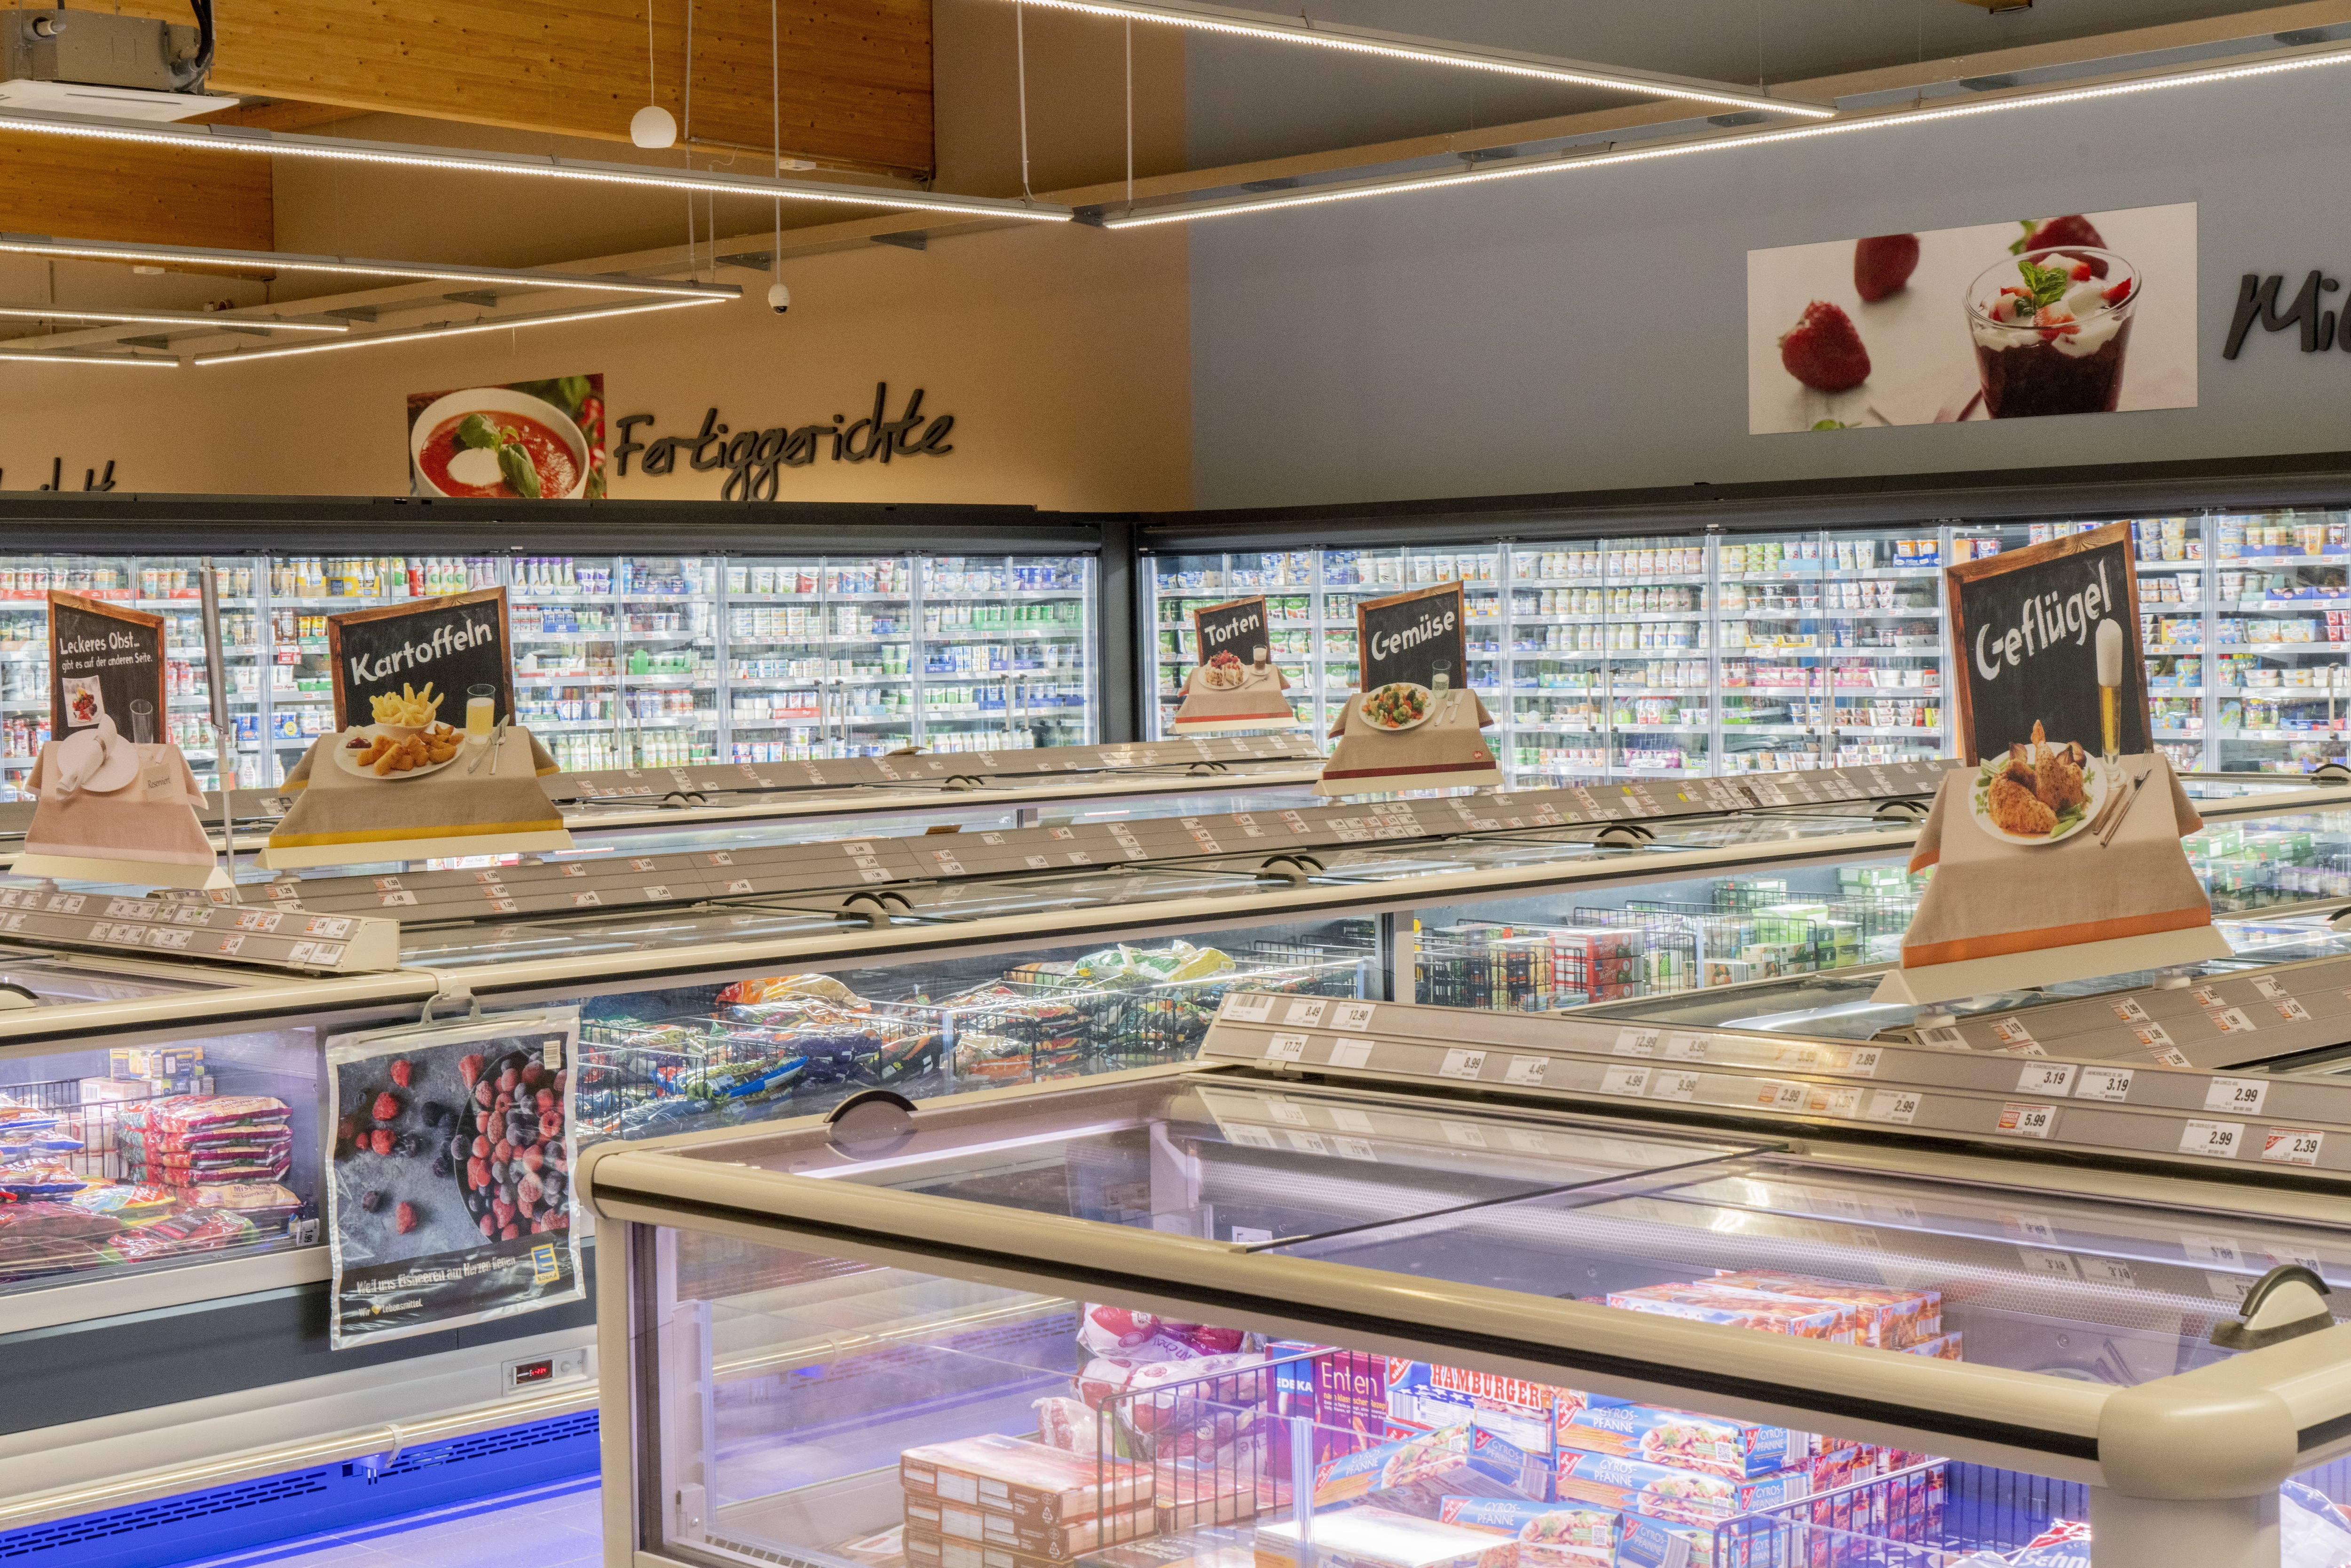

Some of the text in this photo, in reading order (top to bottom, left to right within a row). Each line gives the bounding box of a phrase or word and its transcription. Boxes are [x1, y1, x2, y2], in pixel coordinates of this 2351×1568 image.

[2223, 270, 2351, 360] Mi
[613, 382, 954, 502] Fertiggerichte
[1976, 558, 2111, 680] Geflügel
[1205, 614, 1260, 646] Torten
[1372, 611, 1455, 661] Gemüse
[60, 631, 140, 655] Leckeres Obst...
[351, 619, 492, 685] Kartoffeln
[62, 659, 73, 673] gibt
[84, 657, 94, 668] auf
[96, 655, 106, 666] der
[108, 655, 133, 666] anderen
[135, 652, 152, 663] Seite.
[147, 775, 171, 788] Reserviert
[2269, 981, 2283, 991] 2.49
[2204, 989, 2219, 1000] 2.99
[1305, 1006, 1321, 1017] 8.49
[1349, 1009, 1368, 1021] 12.90
[2126, 1004, 2140, 1015] 2.99
[2288, 1004, 2303, 1014] 2.49
[2225, 1015, 2240, 1025] 1.99
[2007, 1024, 2022, 1034] 3.19
[2148, 1029, 2163, 1040] 2.89
[1283, 1041, 1302, 1052] 17.72
[1635, 1036, 1657, 1048] 12.99
[1689, 1040, 1708, 1052] 8.99
[1464, 1056, 1480, 1070] 8.99
[1856, 1053, 1876, 1066] 2.89
[2168, 1054, 2184, 1065] 2.99
[1529, 1064, 1546, 1075] 4.49
[1625, 1075, 1643, 1087] 4.99
[2043, 1072, 2066, 1084] 3.19
[2106, 1078, 2129, 1091] 3.19
[1677, 1079, 1696, 1092] 9.99
[1781, 1089, 1801, 1103] 2.99
[2234, 1088, 2258, 1102] 2.99
[1894, 1100, 1915, 1113] 2.99
[2025, 1114, 2046, 1127] 5.99
[2209, 1131, 2233, 1145] 2.99
[2293, 1139, 2318, 1153] 2.39
[304, 1229, 313, 1243] 1.99
[357, 1279, 378, 1295] Weil
[379, 1277, 396, 1291] uns
[447, 1268, 462, 1279] am
[464, 1259, 490, 1277] Herzen
[538, 1273, 558, 1282] EDEKA
[359, 1298, 423, 1317] Wir Lebensmittel.
[1277, 1377, 1313, 1392] EDEKA
[1321, 1362, 1378, 1397] Enten
[1431, 1364, 1541, 1410] HAMBURGER
[1337, 1393, 1368, 1406] klassscher
[1599, 1407, 1638, 1422] GYROS-
[1593, 1417, 1634, 1434] PFANNE
[1760, 1428, 1786, 1440] GYROS-
[1491, 1440, 1522, 1461] GYROS-
[1757, 1441, 1783, 1452] PFANNE
[1352, 1448, 1384, 1464] GYROS-
[1346, 1457, 1379, 1476] PFANNE
[1599, 1459, 1638, 1473] GYROS-
[1594, 1470, 1633, 1487] PFANNE
[1756, 1486, 1783, 1498] GYROS-
[1484, 1502, 1521, 1514] GYROS-
[1752, 1498, 1780, 1510] PFANNE
[1477, 1513, 1515, 1526] PFANNE
[1641, 1527, 1667, 1544] GYROS-
[1634, 1535, 1662, 1556] PFANNE
[1755, 1537, 1781, 1551] GYRS-
[1751, 1549, 1779, 1563] PFANE
